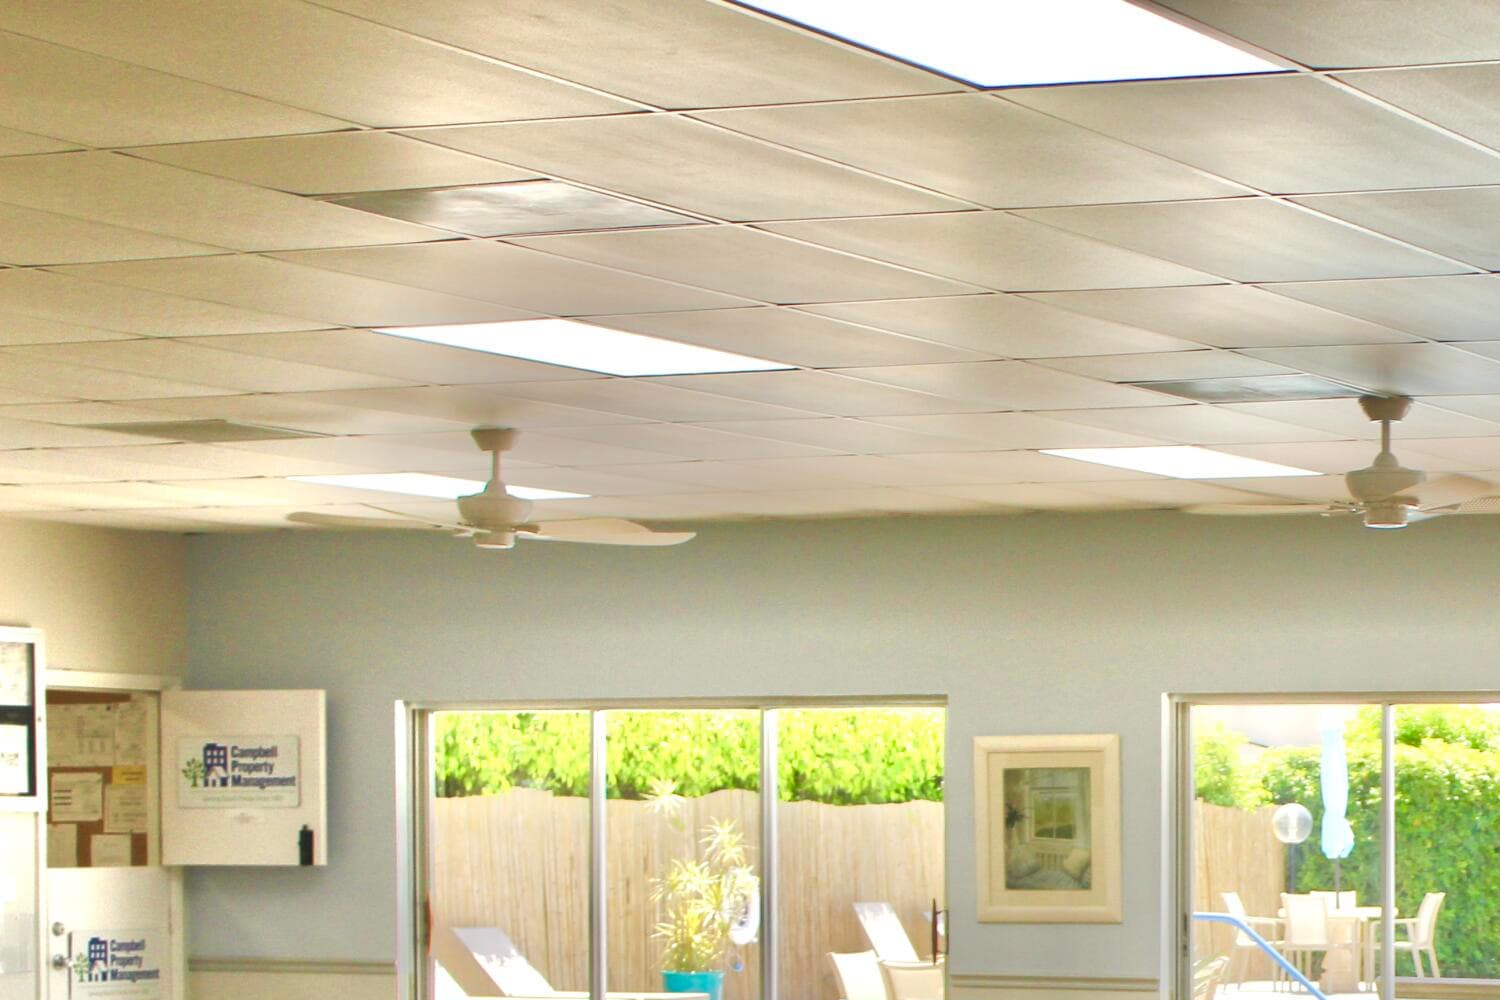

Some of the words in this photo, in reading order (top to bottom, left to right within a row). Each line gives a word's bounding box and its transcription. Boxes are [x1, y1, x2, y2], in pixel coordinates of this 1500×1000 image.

[231, 745, 278, 760] Campbell
[231, 760, 274, 775] Property
[231, 774, 296, 789] Management
[110, 939, 146, 953] Campbell
[110, 953, 143, 968] Property
[110, 969, 160, 983] Management
